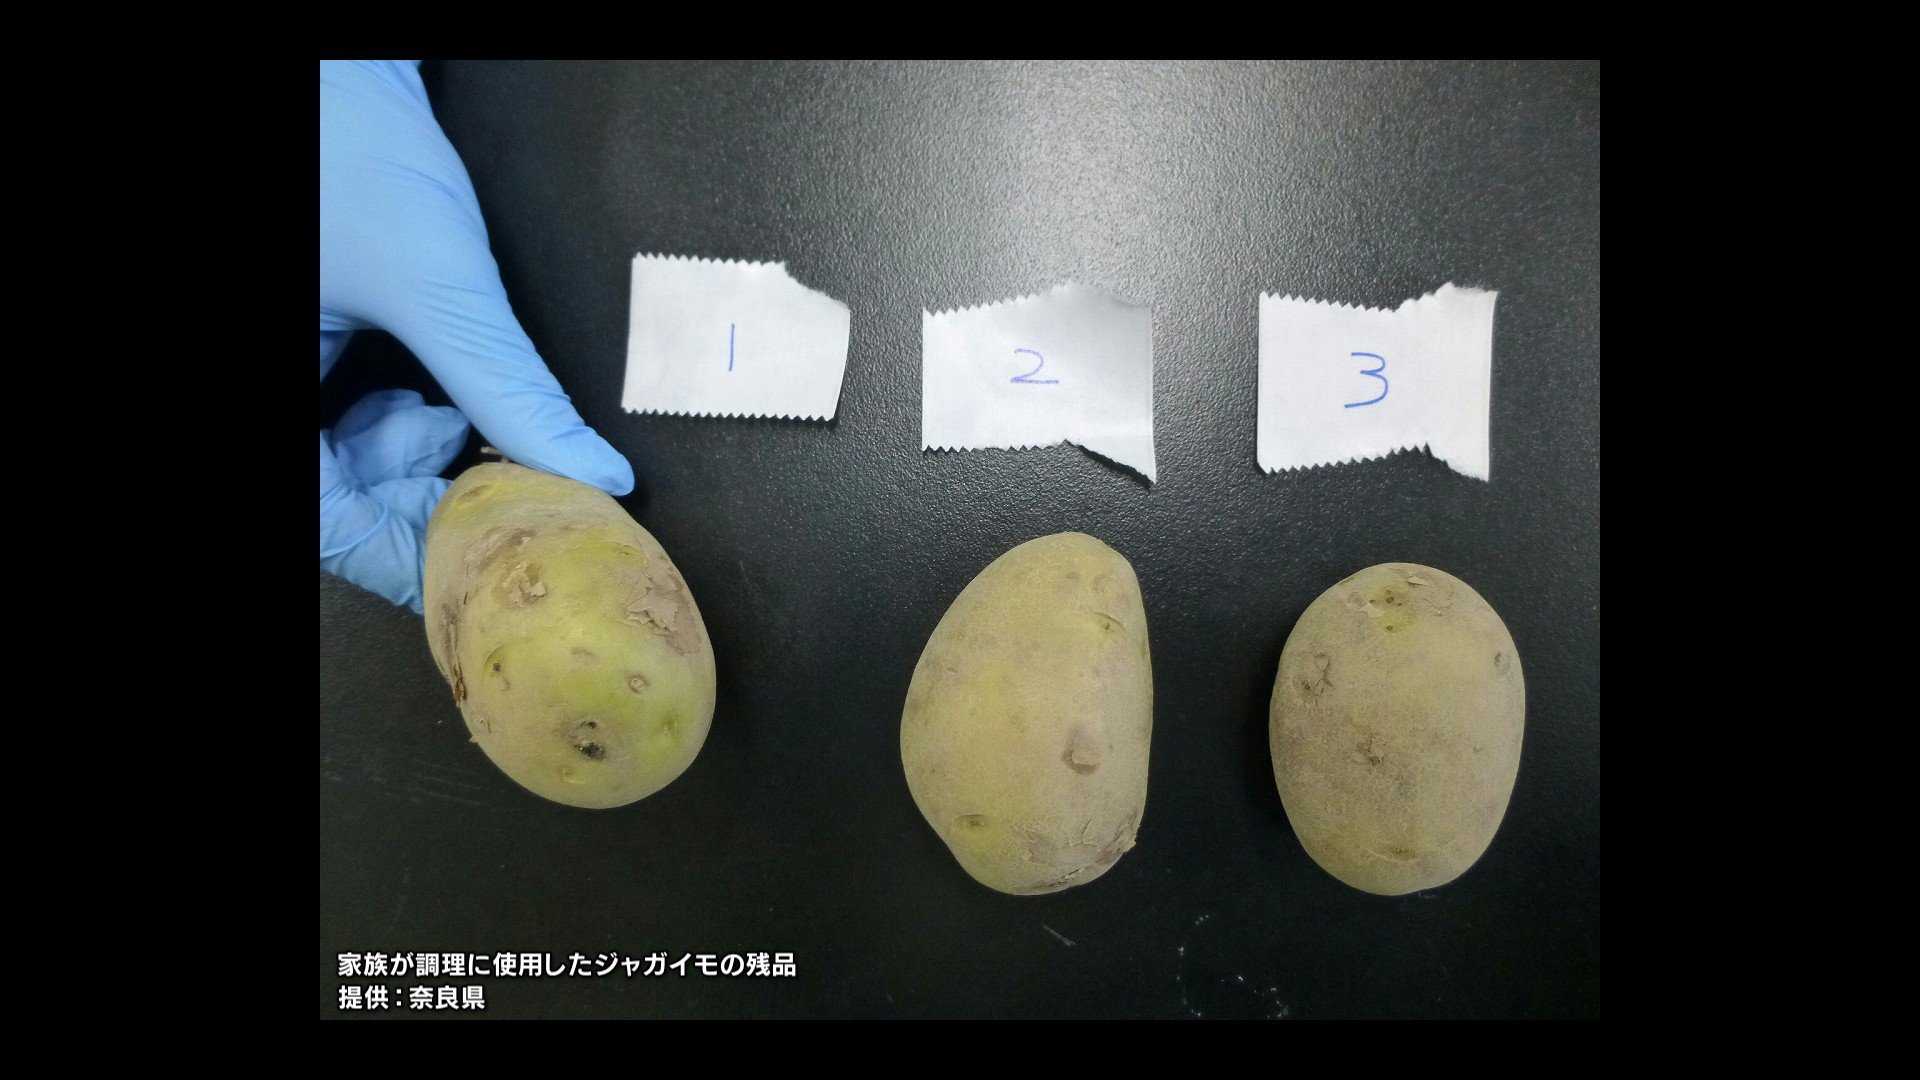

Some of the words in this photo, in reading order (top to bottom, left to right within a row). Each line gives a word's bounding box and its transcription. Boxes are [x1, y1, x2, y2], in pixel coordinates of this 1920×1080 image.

[728, 322, 737, 372] 1
[1011, 348, 1060, 385] 2
[1343, 352, 1390, 408] 3
